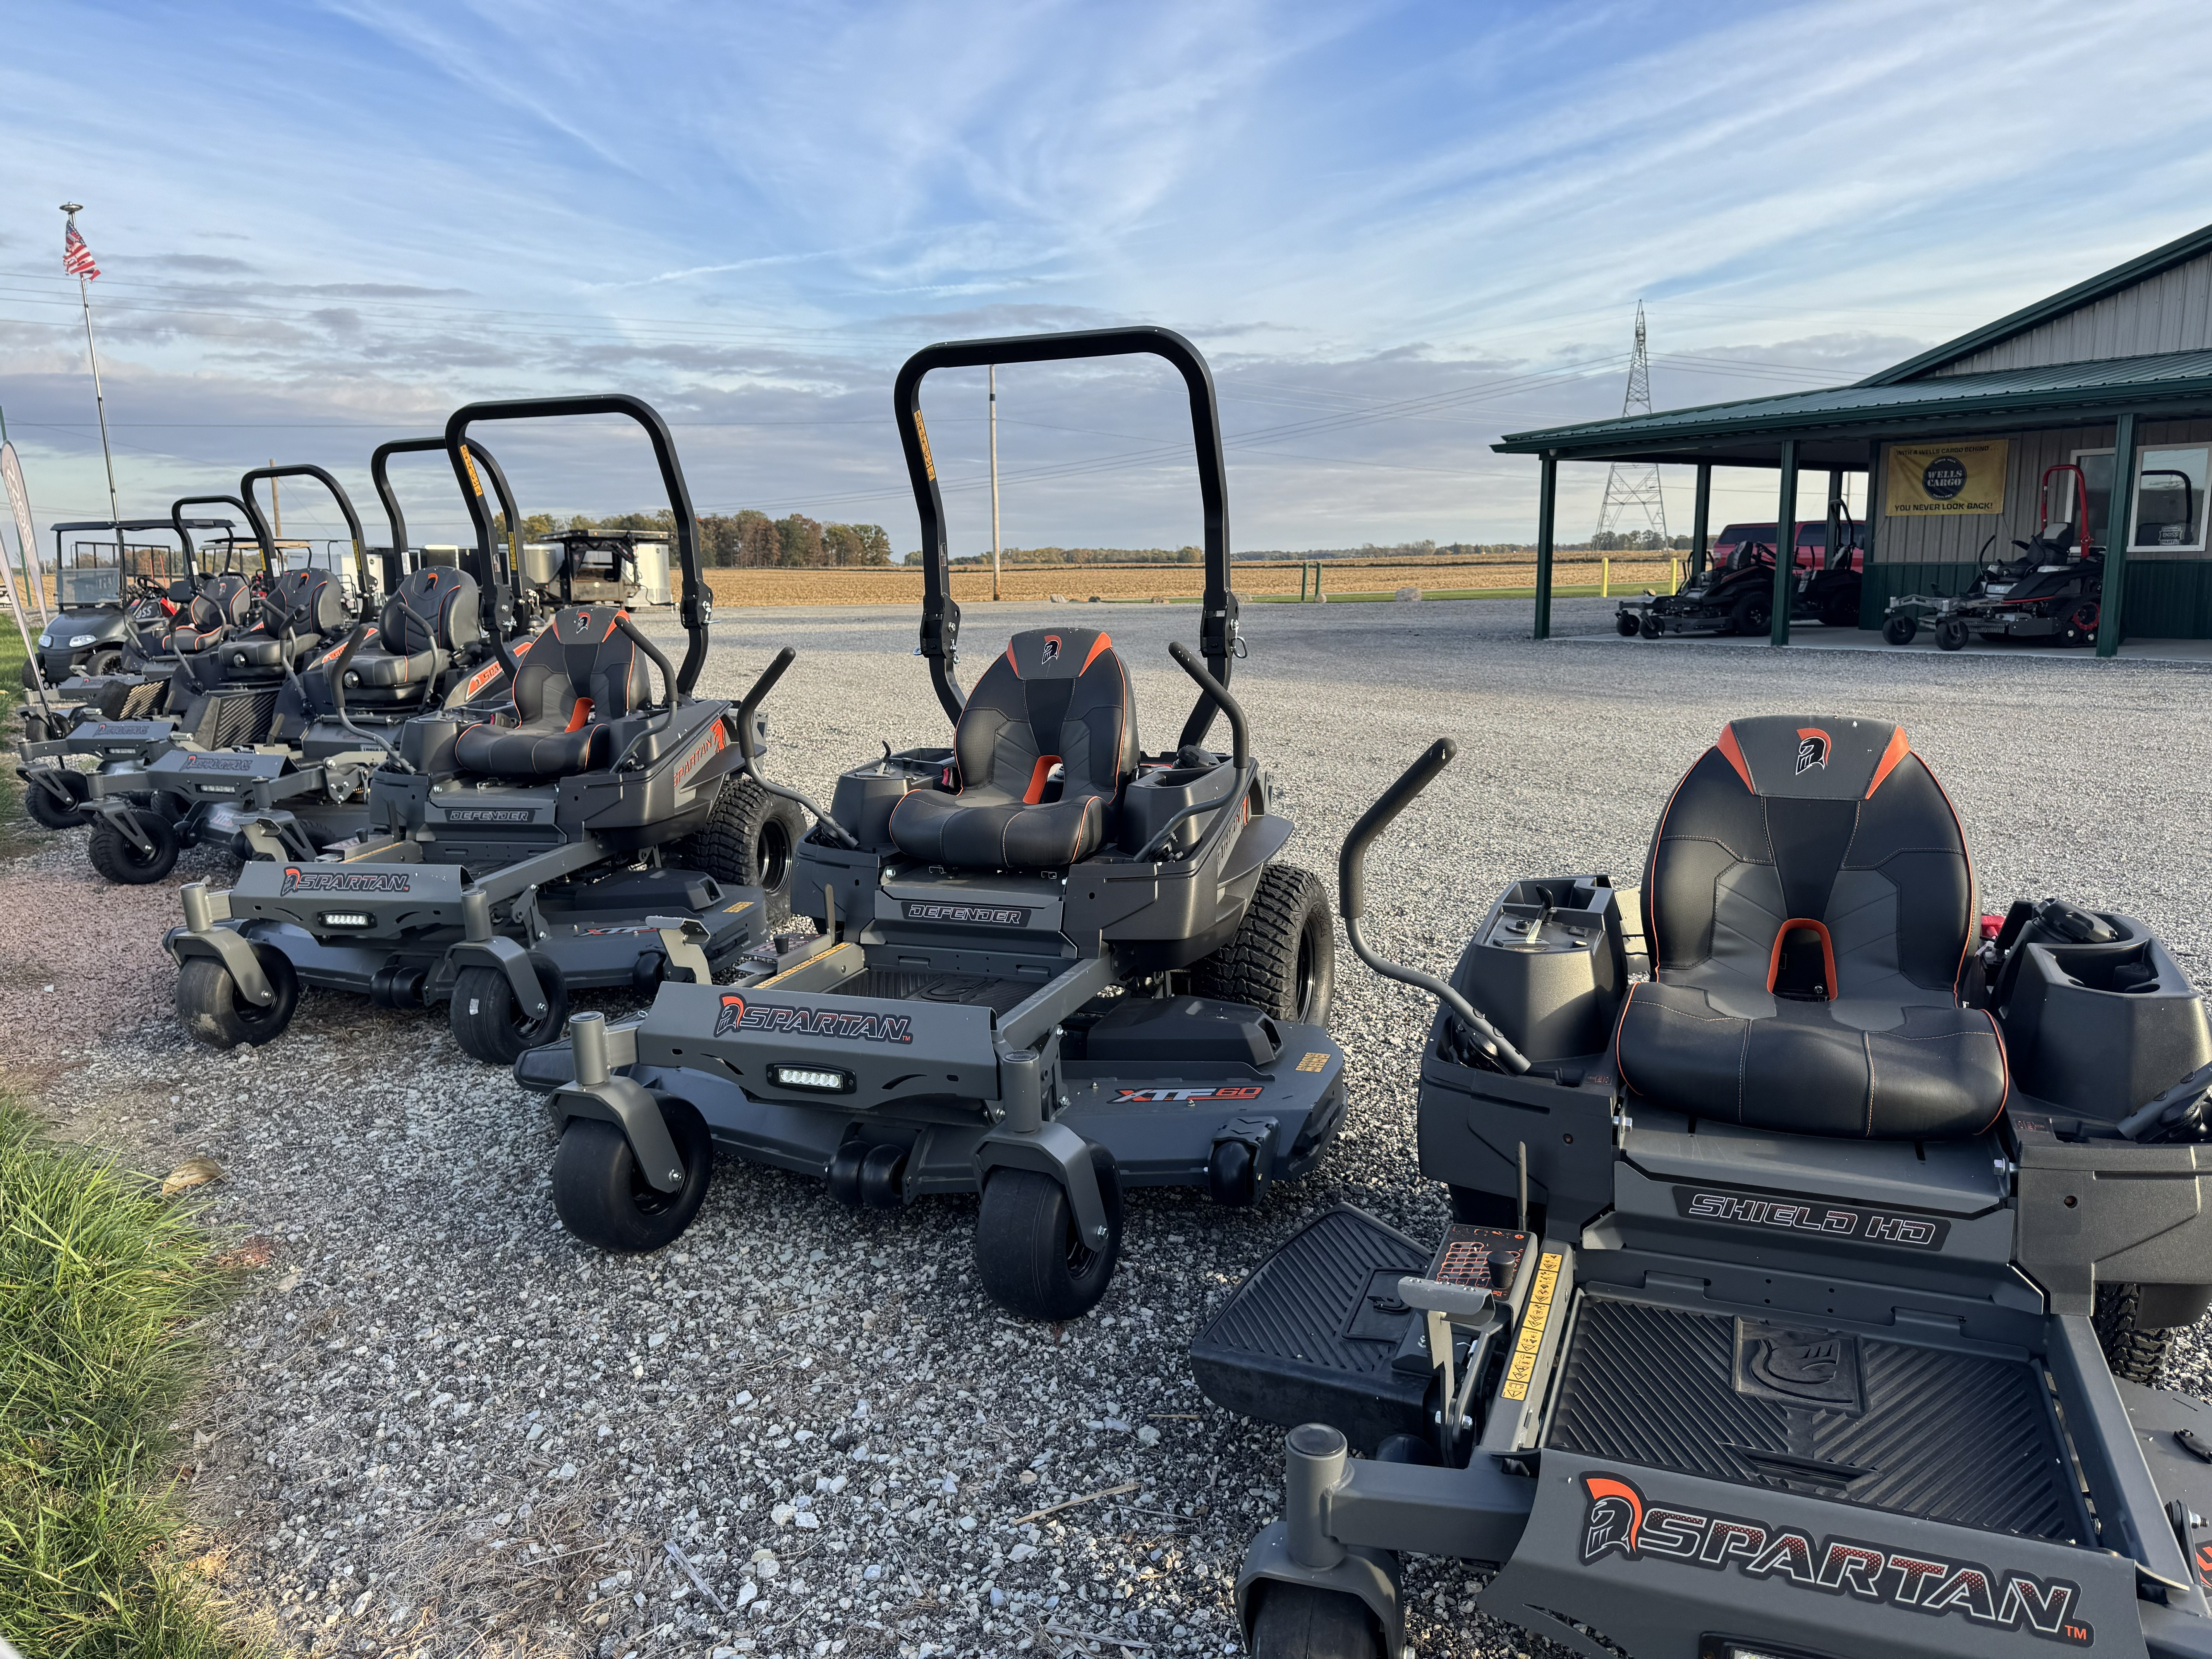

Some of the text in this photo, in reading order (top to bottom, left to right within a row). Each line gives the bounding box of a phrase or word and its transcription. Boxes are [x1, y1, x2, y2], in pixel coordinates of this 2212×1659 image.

[1927, 478, 1961, 487] CARGO
[1928, 470, 1962, 479] WELLS
[450, 810, 529, 821] DEFENDER
[297, 874, 407, 890] SPARTAN
[908, 904, 1021, 924] DEFENDER
[739, 1006, 908, 1040] SPARTAN
[1688, 1194, 1936, 1245] SHIELD HD
[1638, 1507, 2087, 1641] SPARTAN TM
